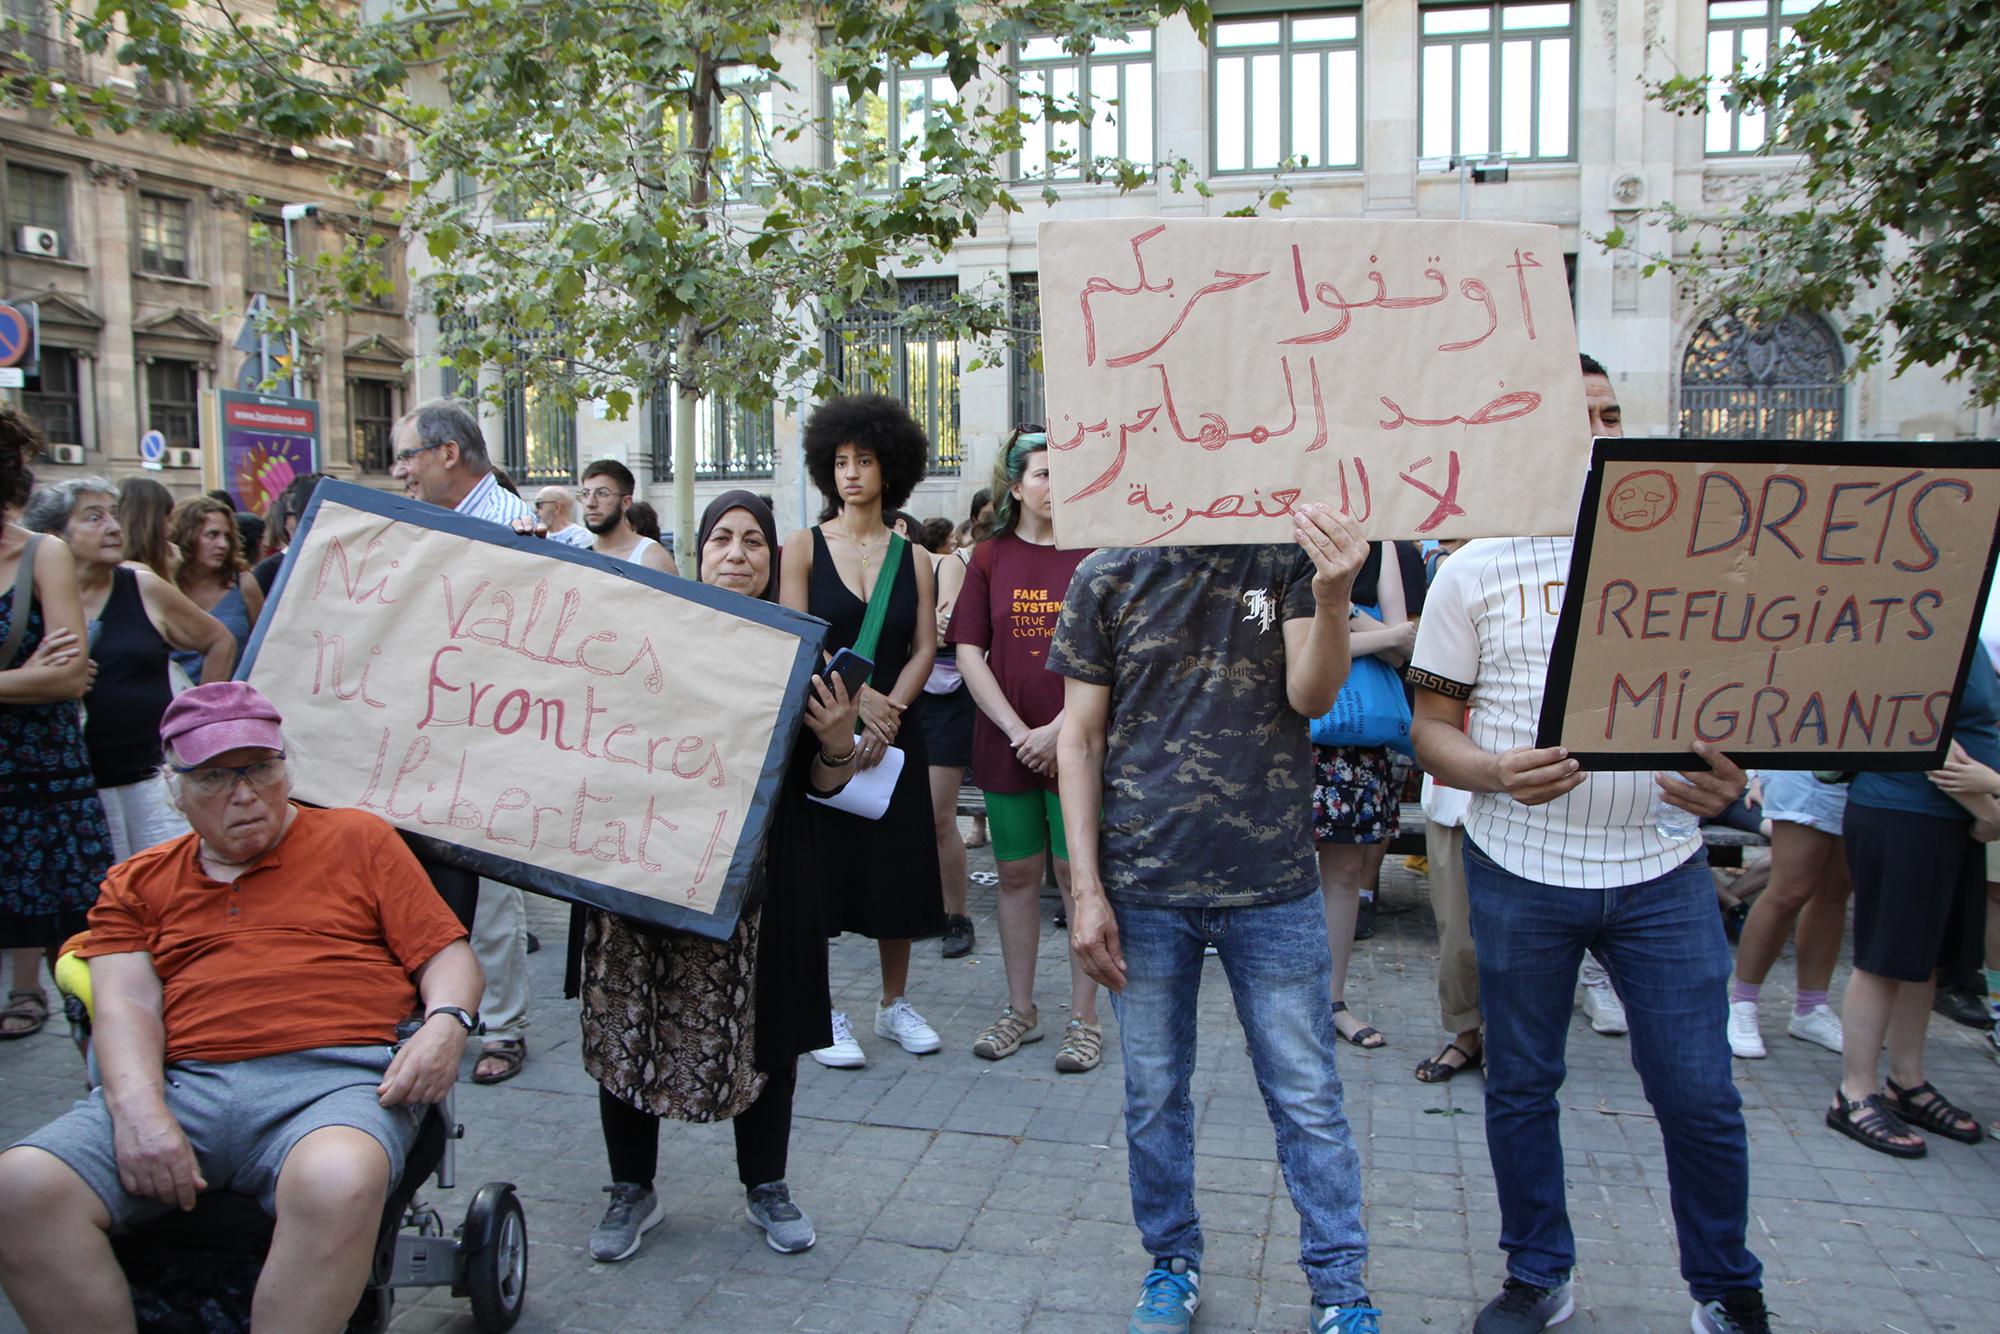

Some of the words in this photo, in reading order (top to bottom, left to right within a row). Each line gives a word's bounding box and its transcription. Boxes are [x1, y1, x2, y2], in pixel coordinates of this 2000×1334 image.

[1046, 355, 1328, 504] المهاجرين
[1379, 380, 1543, 431] ضد
[1686, 470, 1974, 573] DRETS
[314, 535, 400, 604] Ni
[1013, 589, 1048, 600] FAKE
[1010, 615, 1046, 626] TRUE
